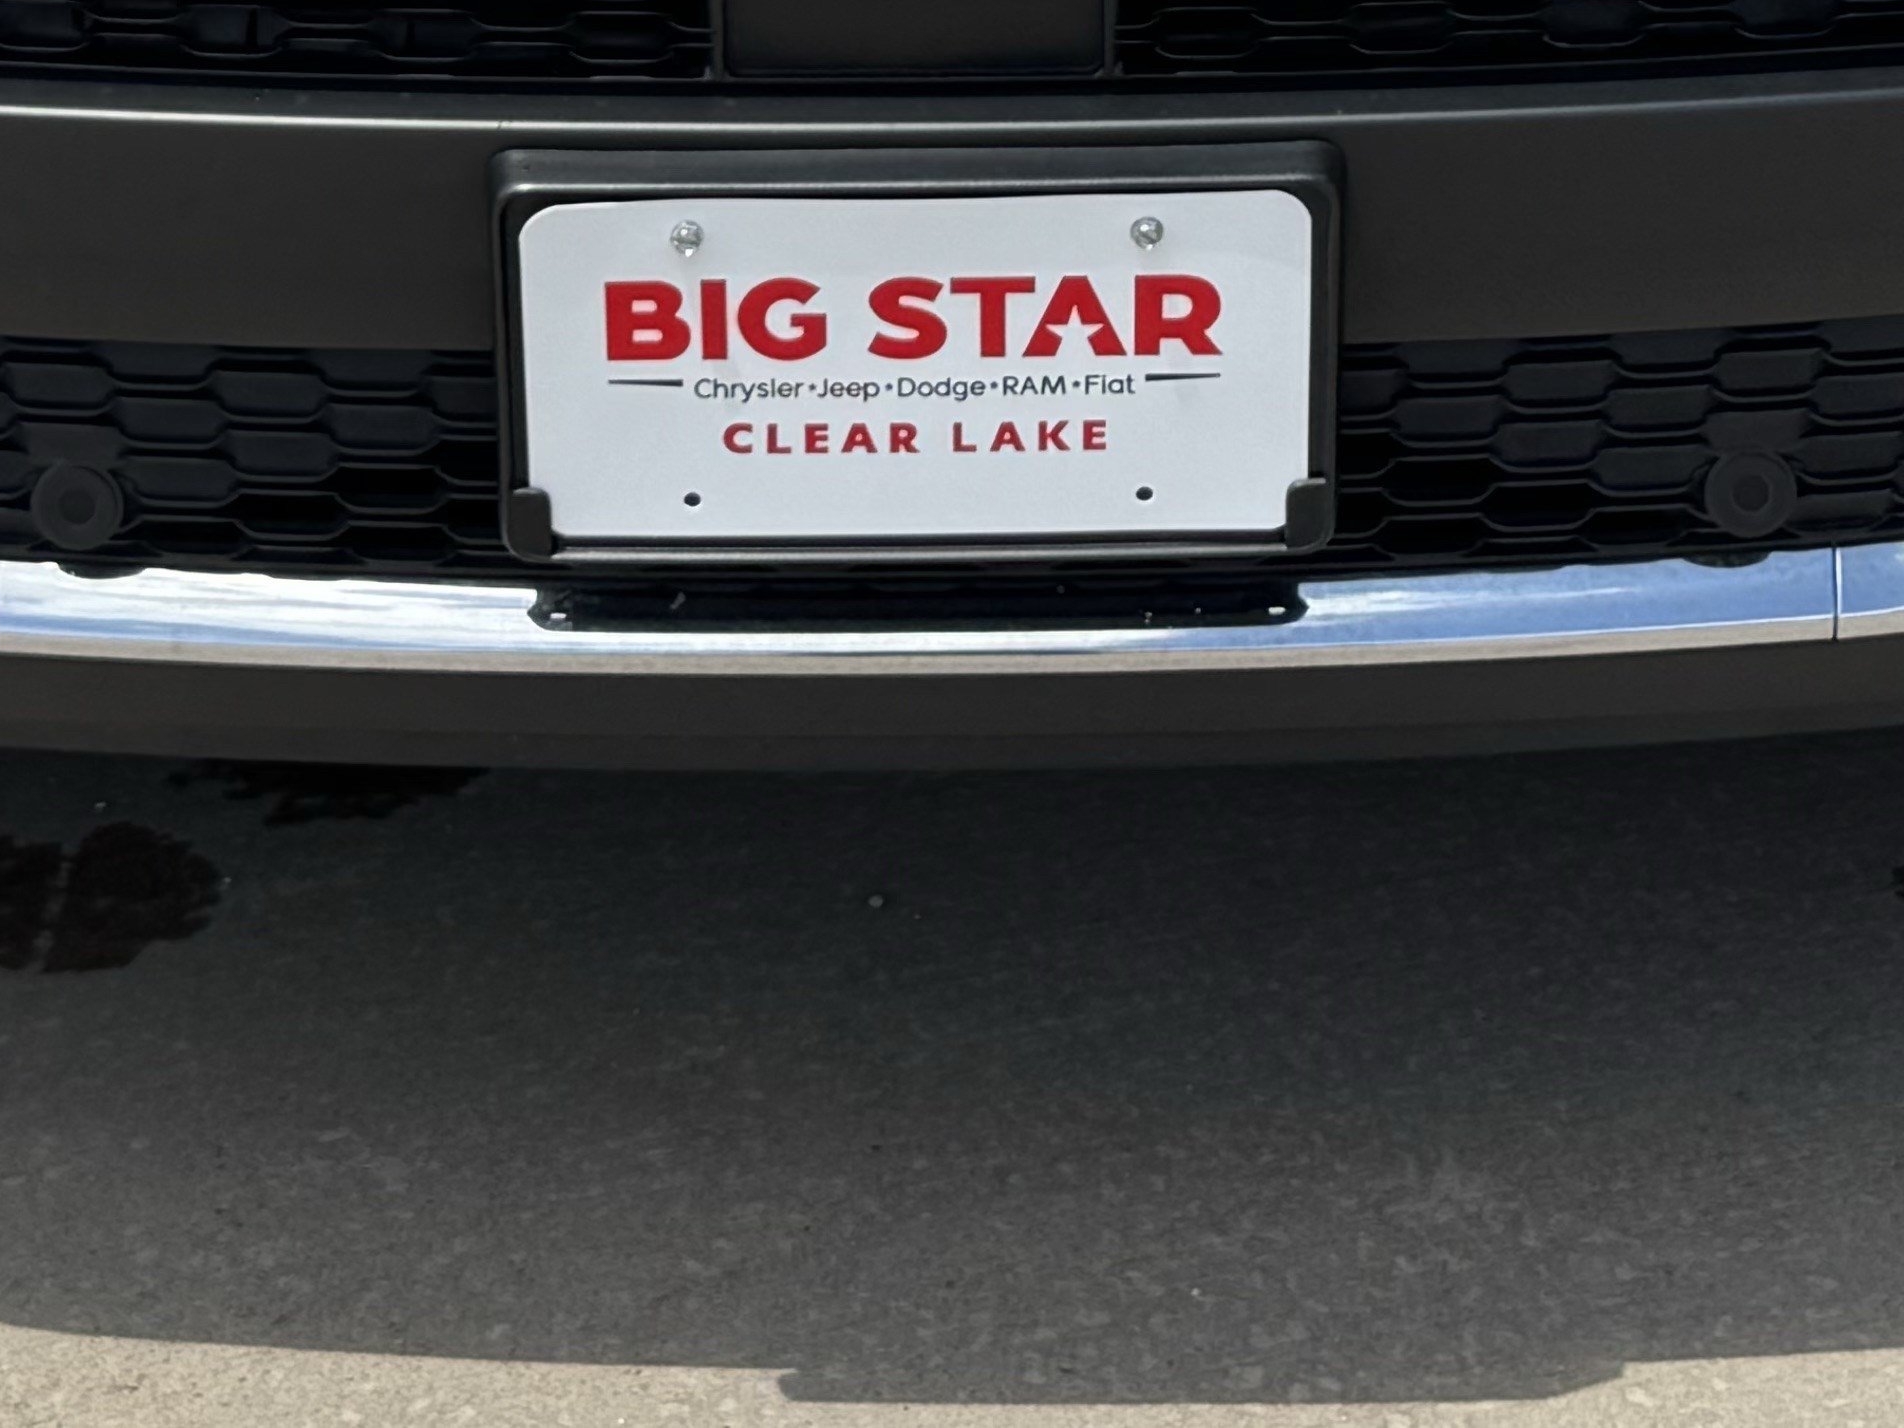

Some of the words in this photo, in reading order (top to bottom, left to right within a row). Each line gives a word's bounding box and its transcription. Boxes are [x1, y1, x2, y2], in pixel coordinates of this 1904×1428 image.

[603, 277, 828, 361] BIG
[867, 274, 1223, 360] STAR
[694, 377, 804, 402] Chrysler
[817, 378, 881, 402] Jeep
[896, 376, 986, 401] Dodge
[1001, 374, 1067, 395] RAM
[1083, 373, 1137, 395] Fiat
[722, 422, 921, 454] CLEAR
[952, 419, 1107, 453] LAKE
